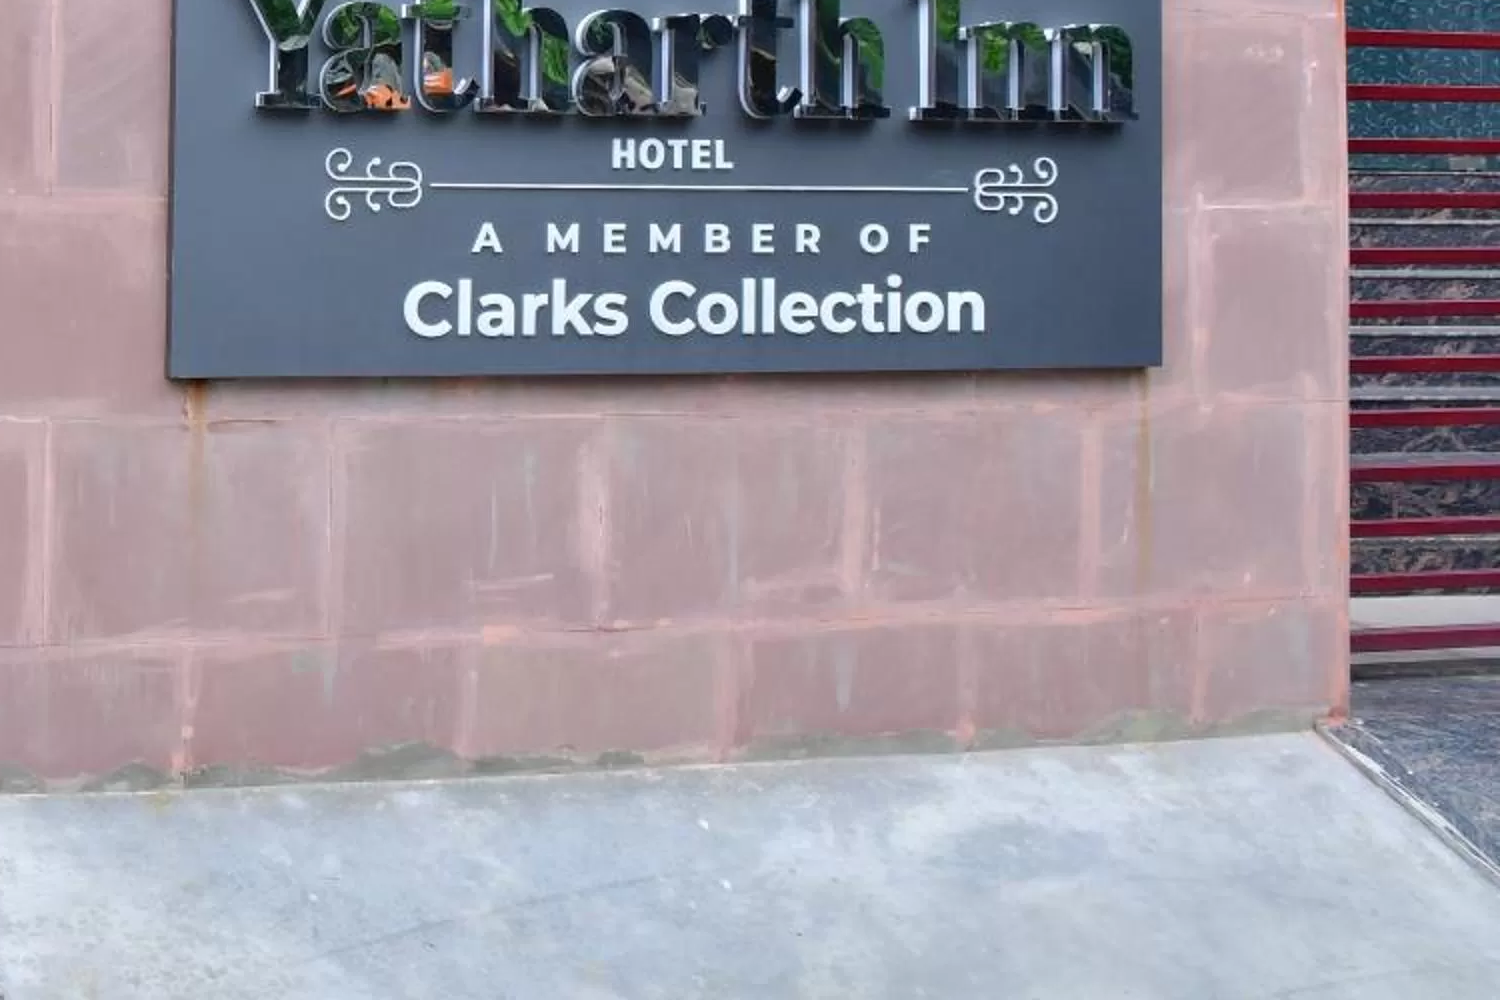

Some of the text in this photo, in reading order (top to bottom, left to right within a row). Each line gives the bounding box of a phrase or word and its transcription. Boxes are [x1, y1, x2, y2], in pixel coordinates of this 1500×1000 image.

[611, 138, 735, 171] HOTEL
[471, 223, 932, 255] A MEMBER OF
[403, 274, 986, 338] Clarks Collection
